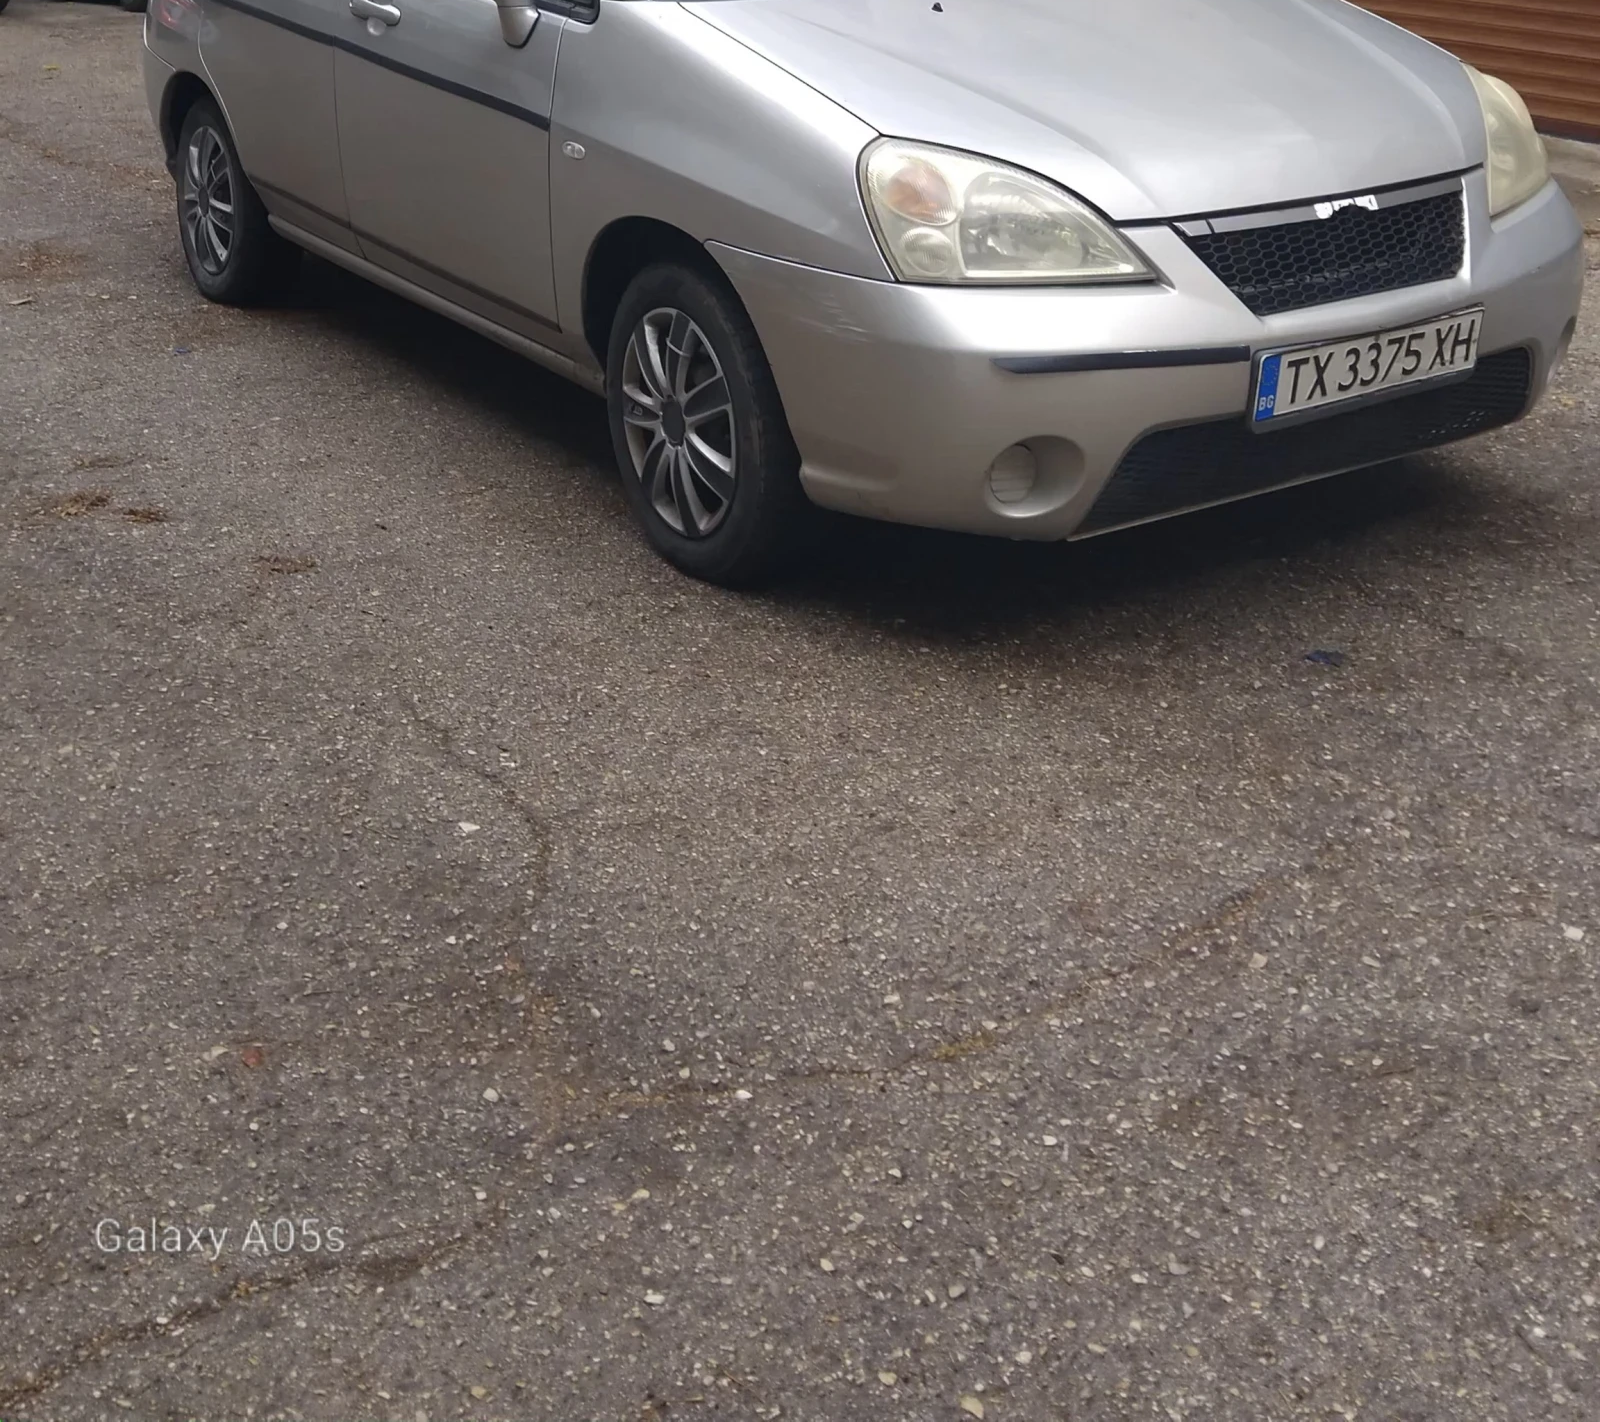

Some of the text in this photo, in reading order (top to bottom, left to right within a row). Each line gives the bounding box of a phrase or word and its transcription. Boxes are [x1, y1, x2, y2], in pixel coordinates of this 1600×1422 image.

[1286, 318, 1476, 405] TX 3375 XH
[1258, 394, 1274, 412] BG
